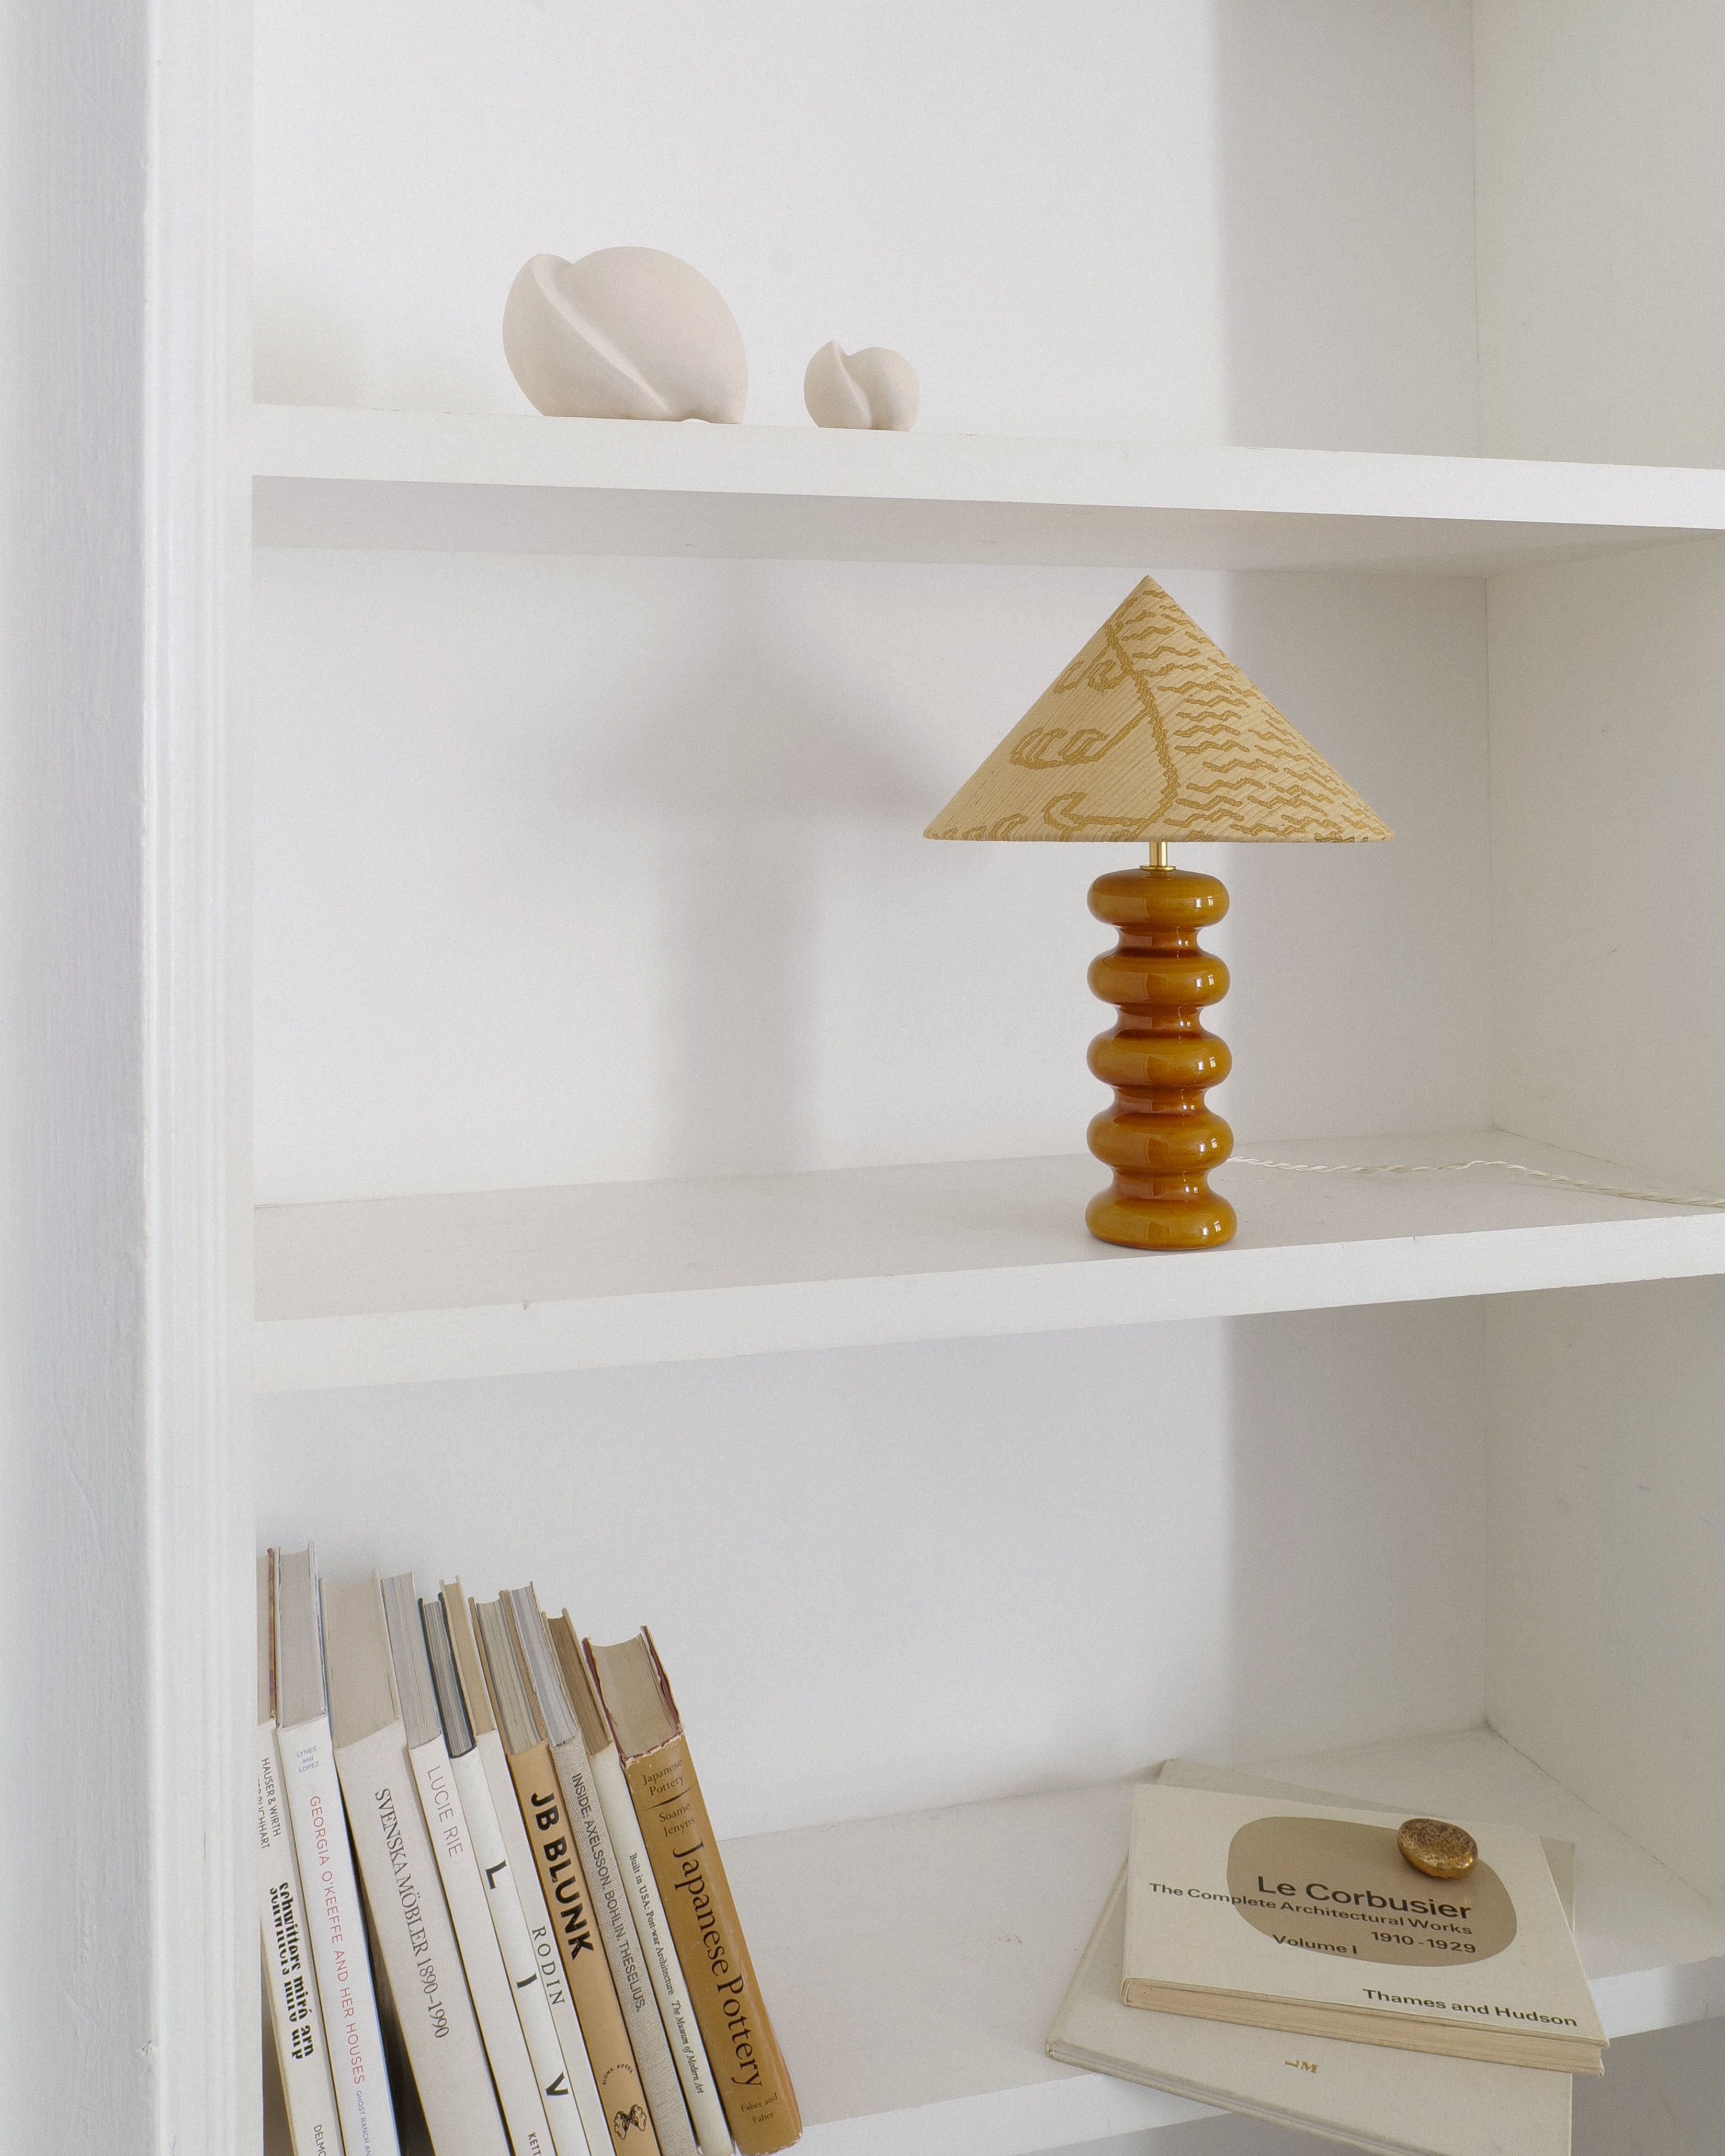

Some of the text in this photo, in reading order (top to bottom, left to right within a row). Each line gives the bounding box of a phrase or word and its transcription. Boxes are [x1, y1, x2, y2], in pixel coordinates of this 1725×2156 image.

[297, 1746, 317, 1757] LYNES
[298, 1761, 320, 1773] LOPEZ
[643, 1759, 683, 1785] Japanese
[649, 1774, 684, 1796] Pottery
[262, 1757, 275, 1797] HAUSER
[269, 1805, 281, 1837] WIRTH
[427, 1765, 463, 1858] LUCIE RIE
[659, 1804, 691, 1822] Soame
[310, 1796, 330, 1866] GEORGIA
[663, 1817, 695, 1838] Jenyns
[375, 1787, 410, 1875] SVENSKA
[396, 1873, 428, 1957] MÖBLER
[531, 1792, 595, 1961] JB BLUNK
[1149, 1883, 1472, 1935] The Complete Architectural Works
[1257, 1875, 1472, 1919] Le Corbusier
[630, 1853, 640, 1874] Built
[635, 1874, 643, 1885] in
[646, 1910, 660, 1946] Post-war
[656, 1946, 674, 1996] Architecture
[1273, 1934, 1347, 1954] Volume
[334, 1950, 348, 1982] AND
[532, 1925, 565, 2005] RODIN
[673, 1839, 763, 2087] Japanese Pottery
[340, 1987, 354, 2018] HER
[1362, 1988, 1578, 2027] Thames and Hudson
[346, 2022, 365, 2084] HOUSES
[672, 2000, 704, 2094] The Museum of Modern Art
[602, 2063, 633, 2085] BLUNK BOOKS
[356, 2090, 365, 2115] GHOST
[741, 2092, 778, 2112] Faber and
[753, 2112, 774, 2124] Faber
[360, 2117, 369, 2143] RANCH
